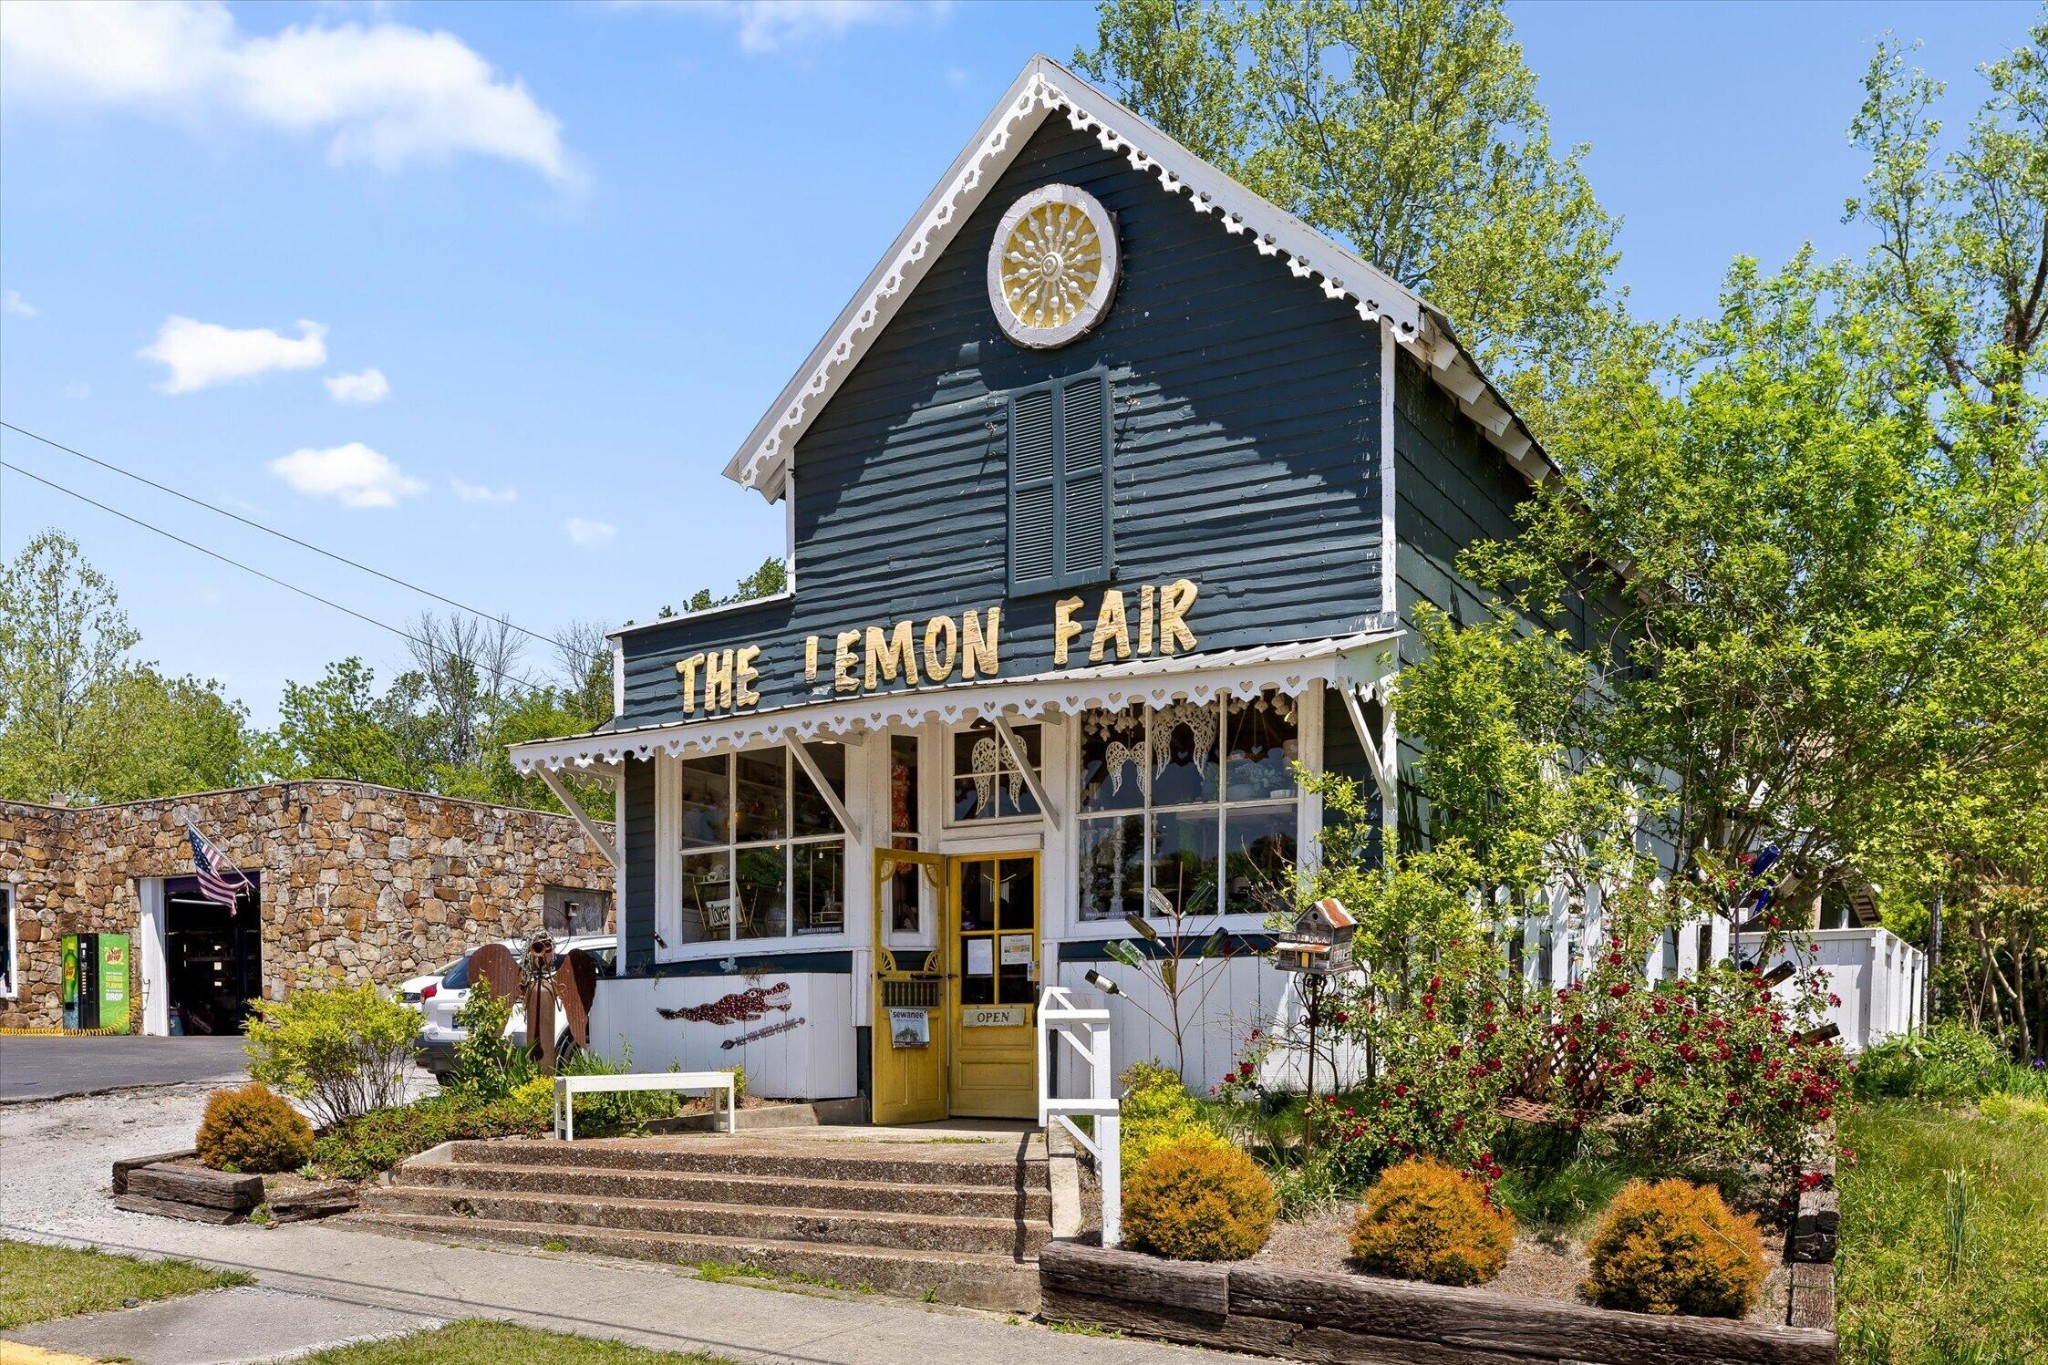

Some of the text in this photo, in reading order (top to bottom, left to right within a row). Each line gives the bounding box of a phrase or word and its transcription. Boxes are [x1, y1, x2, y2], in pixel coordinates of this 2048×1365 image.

[676, 645, 761, 714] THE
[1053, 578, 1199, 665] FAIR
[106, 993, 123, 1001] DROP
[892, 1011, 925, 1019] sewanee
[977, 1011, 1010, 1023] OPEN
[746, 1031, 760, 1043] YOU
[759, 1026, 775, 1038] NEED
[781, 1018, 799, 1031] LOVE
